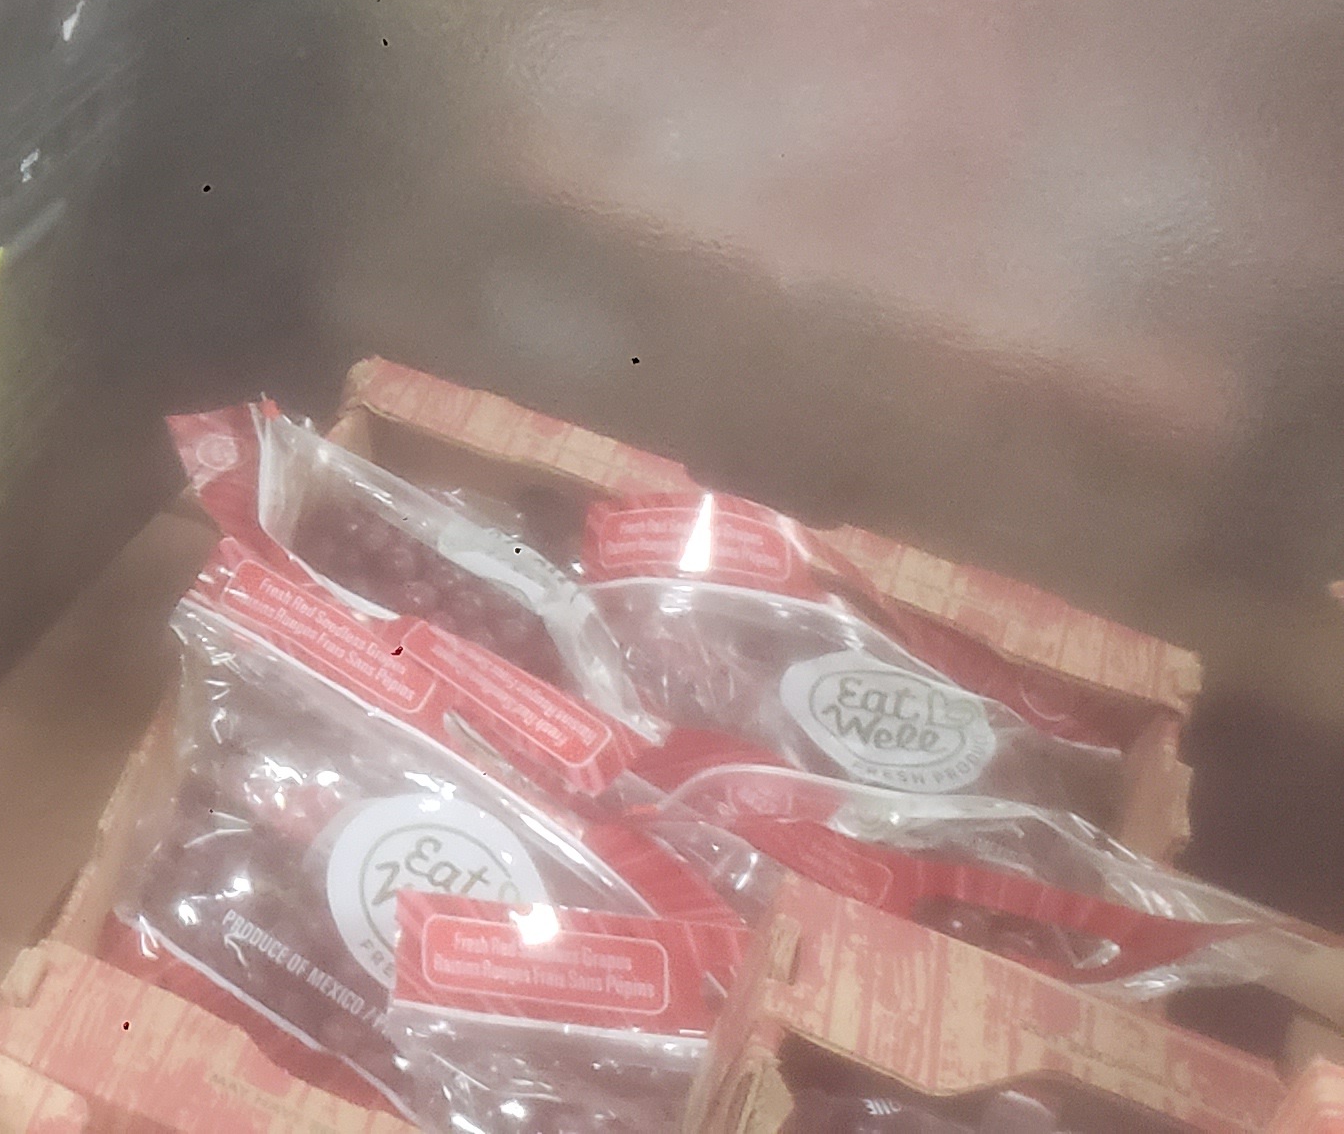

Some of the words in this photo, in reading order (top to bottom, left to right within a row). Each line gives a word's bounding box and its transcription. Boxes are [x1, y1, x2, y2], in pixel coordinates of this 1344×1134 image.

[838, 677, 921, 722] Eat
[822, 704, 951, 753] Well
[405, 835, 491, 896] Eat
[222, 909, 290, 964] PRODUCE
[286, 954, 310, 977] OF
[306, 968, 366, 1015] MEXICO
